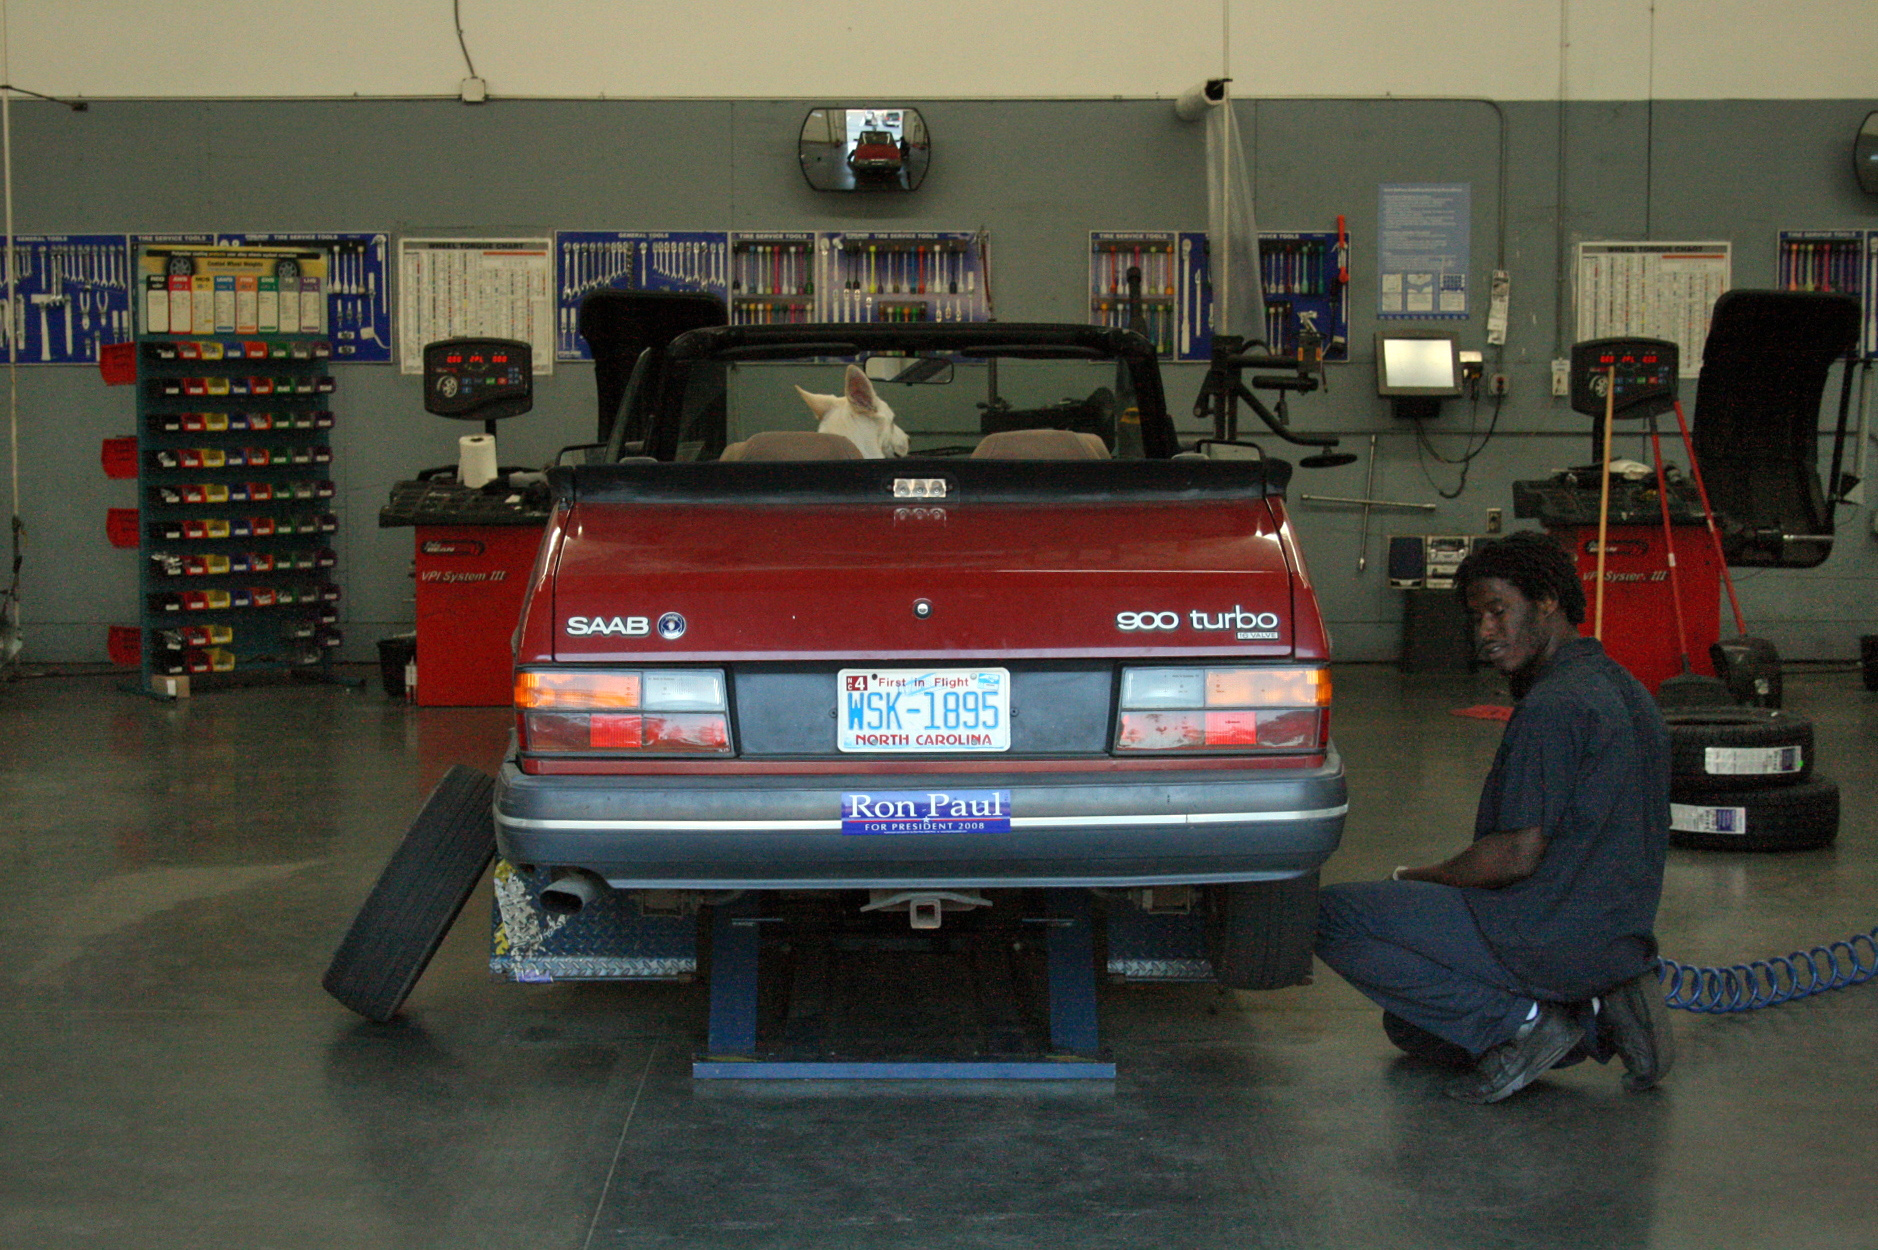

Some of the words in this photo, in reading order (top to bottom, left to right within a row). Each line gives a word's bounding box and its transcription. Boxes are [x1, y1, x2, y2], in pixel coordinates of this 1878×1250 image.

[422, 571, 441, 580] VPI
[443, 571, 486, 583] System
[490, 570, 507, 581] III
[1116, 611, 1180, 630] 900
[1190, 604, 1279, 630] turbo
[566, 616, 650, 635] SAAB
[854, 676, 865, 691] 4
[878, 677, 906, 687] First
[914, 677, 925, 687] in
[934, 677, 969, 689] Flight
[847, 691, 999, 731] WSK-1895
[855, 734, 909, 746] NORTH
[915, 734, 992, 746] CAROLINA
[849, 794, 917, 818] Ron
[926, 791, 1003, 817] Paul
[864, 823, 887, 831] FOR
[891, 822, 953, 831] PRESIDENT
[957, 821, 985, 830] 2008
